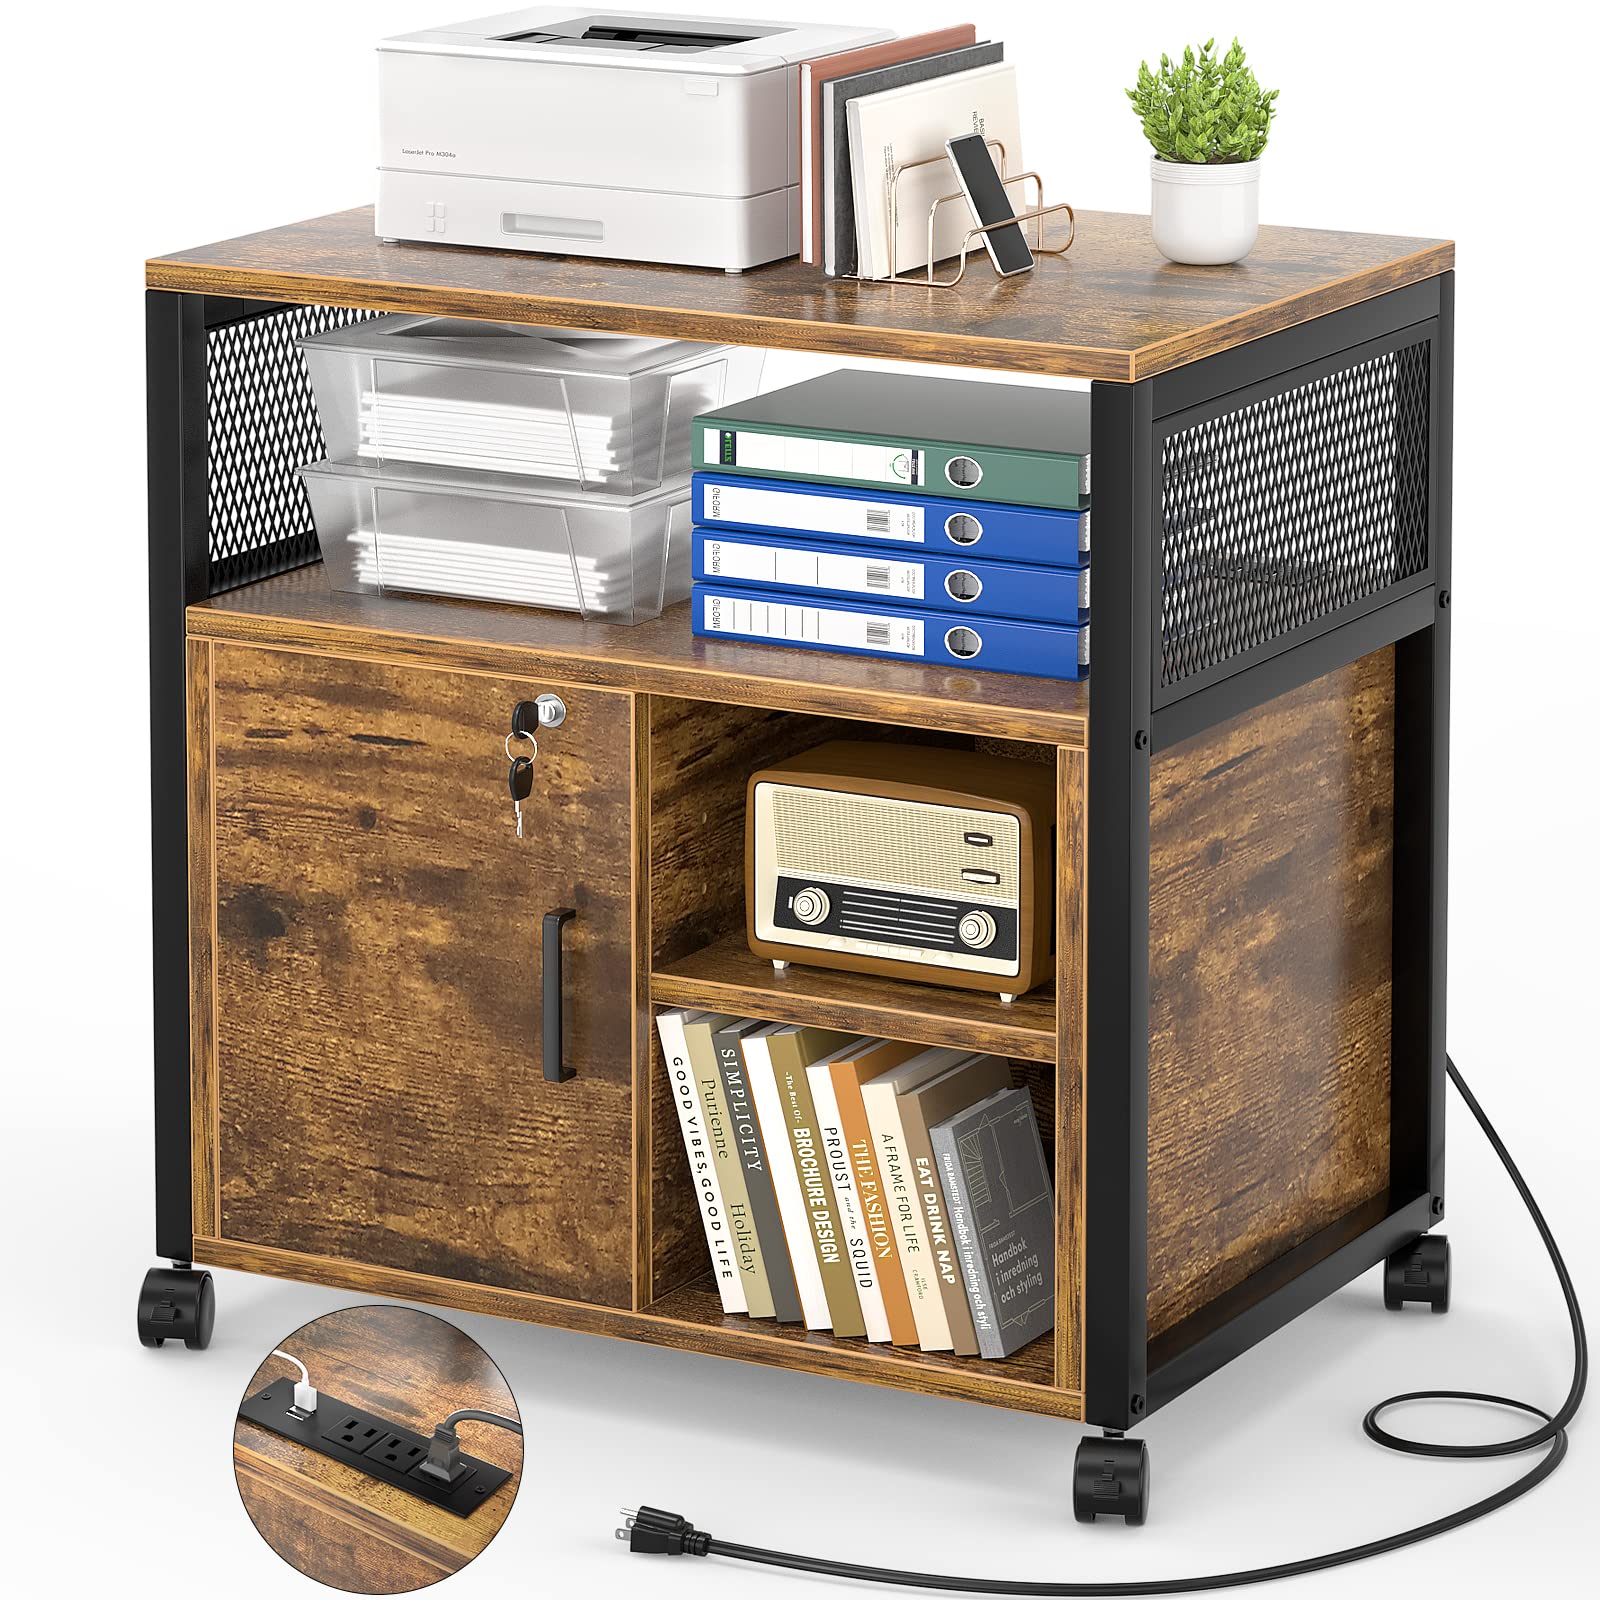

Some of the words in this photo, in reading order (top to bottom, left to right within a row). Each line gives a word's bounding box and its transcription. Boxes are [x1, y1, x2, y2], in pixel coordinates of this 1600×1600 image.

[701, 1078, 728, 1159] Purienne
[720, 1049, 763, 1171] SIMPLICITY
[788, 1091, 797, 1109] Best
[881, 1133, 894, 1143] A
[673, 1057, 693, 1109] GOOD
[687, 1116, 708, 1173] VIBES,
[701, 1178, 721, 1231] GOOD
[715, 1239, 733, 1278] LIFE
[824, 1127, 852, 1191] PROUST
[852, 1139, 874, 1178] THE
[884, 1146, 906, 1193] FRAME
[915, 1157, 934, 1188] EAT
[942, 1152, 954, 1173] FRIDA
[793, 1127, 828, 1207] BROCHURE
[812, 1210, 841, 1264] DESIGN
[845, 1197, 854, 1213] and
[896, 1196, 912, 1222] FOR
[849, 1216, 857, 1229] the
[860, 1181, 893, 1258] FASHION
[923, 1193, 947, 1246] DRINK
[953, 1207, 972, 1246] Handbok
[730, 1203, 756, 1274] Holiday
[903, 1225, 920, 1253] LIFE
[991, 1236, 1028, 1268] Handbok
[850, 1238, 873, 1288] SQUID
[937, 1250, 956, 1285] NAP
[962, 1250, 980, 1293] inredning
[995, 1271, 1001, 1286] i
[1000, 1253, 1039, 1284] inredning
[973, 1293, 987, 1311] och
[1001, 1285, 1016, 1304] och
[1017, 1271, 1043, 1295] styling
